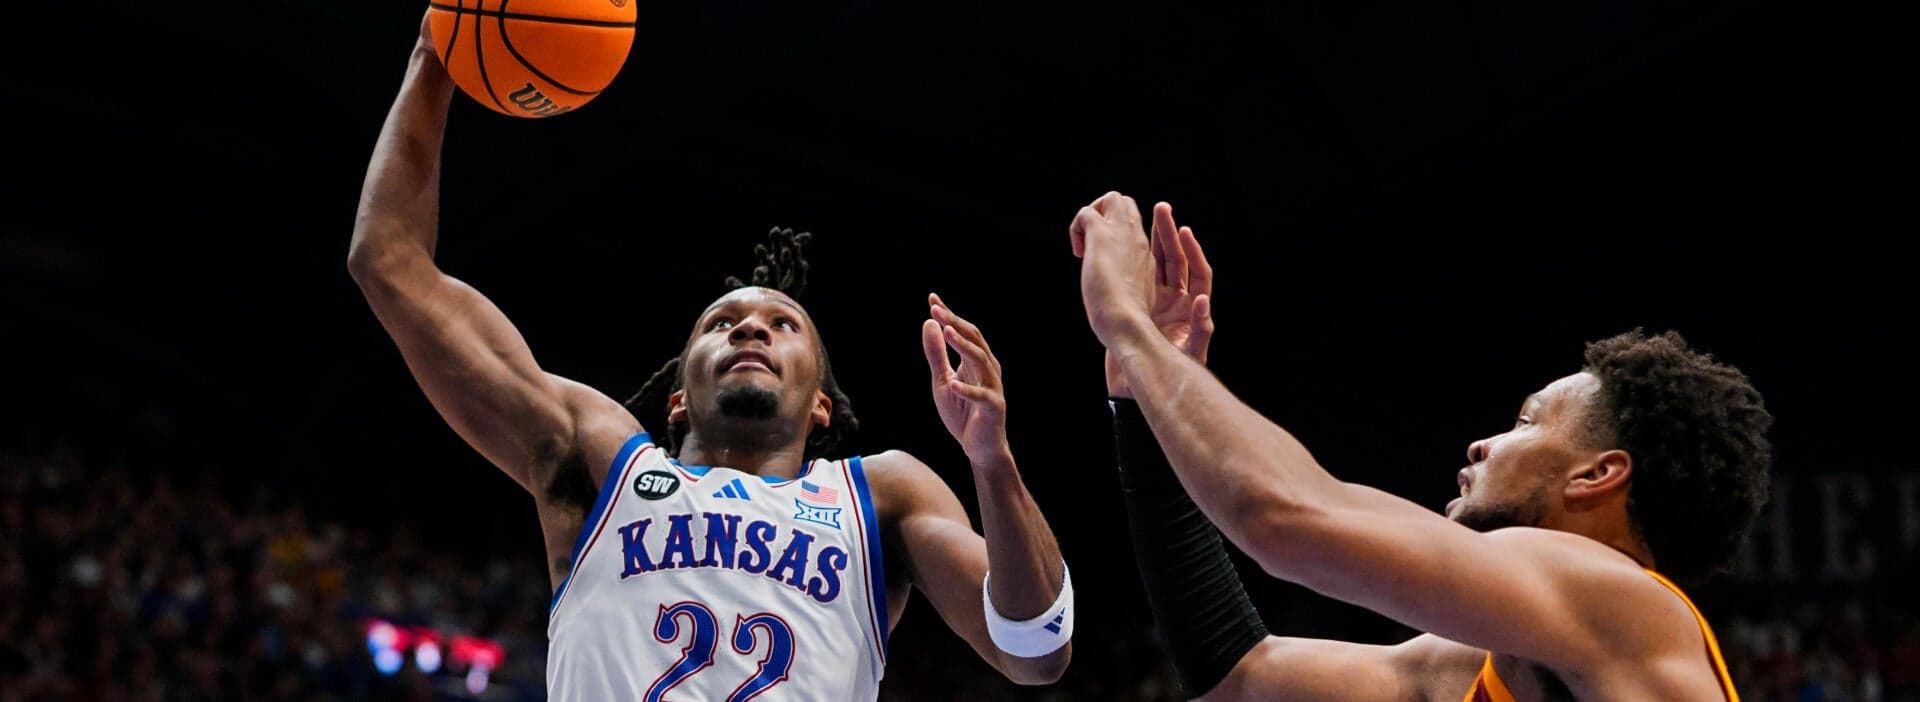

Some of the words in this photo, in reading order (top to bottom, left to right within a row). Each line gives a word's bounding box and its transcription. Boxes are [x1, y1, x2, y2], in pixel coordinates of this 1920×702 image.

[638, 474, 676, 494] SW
[618, 512, 848, 603] KANSAS
[643, 601, 796, 702] 22
